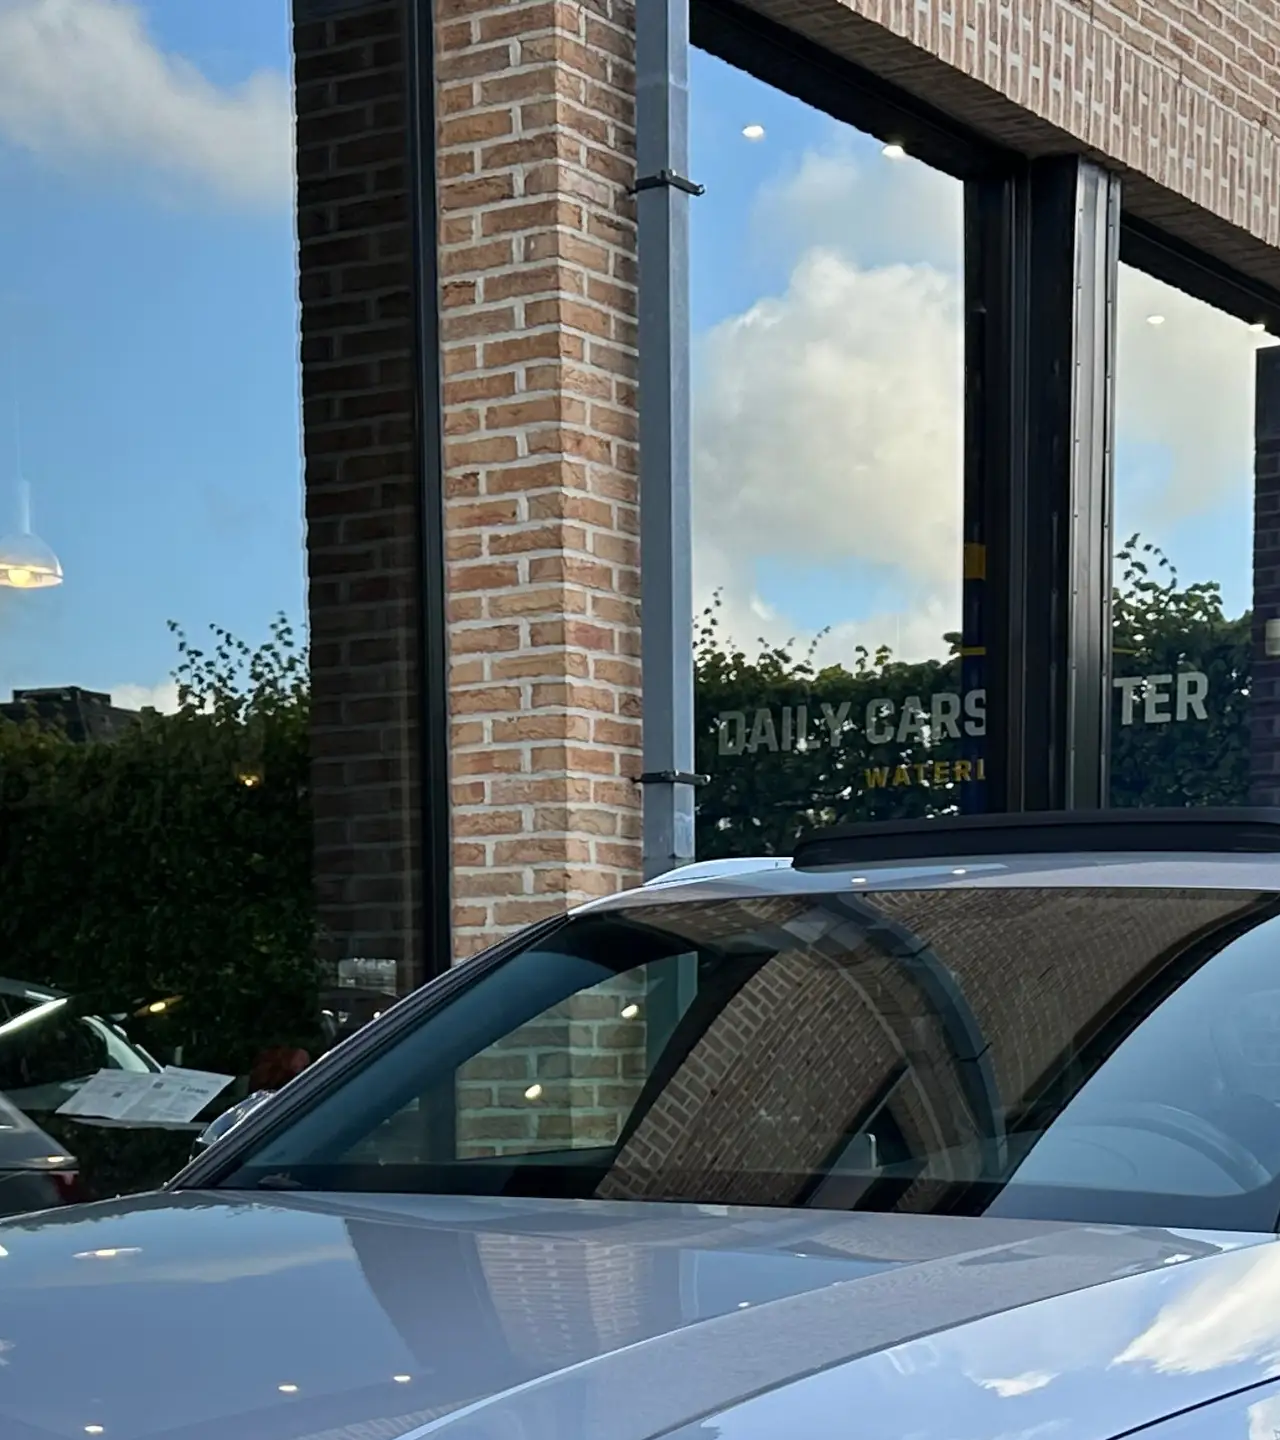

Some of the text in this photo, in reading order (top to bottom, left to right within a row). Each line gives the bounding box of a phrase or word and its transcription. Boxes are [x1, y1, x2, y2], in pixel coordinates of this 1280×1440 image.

[718, 671, 1210, 756] DAILY CARS TER
[864, 758, 986, 788] WATERL
